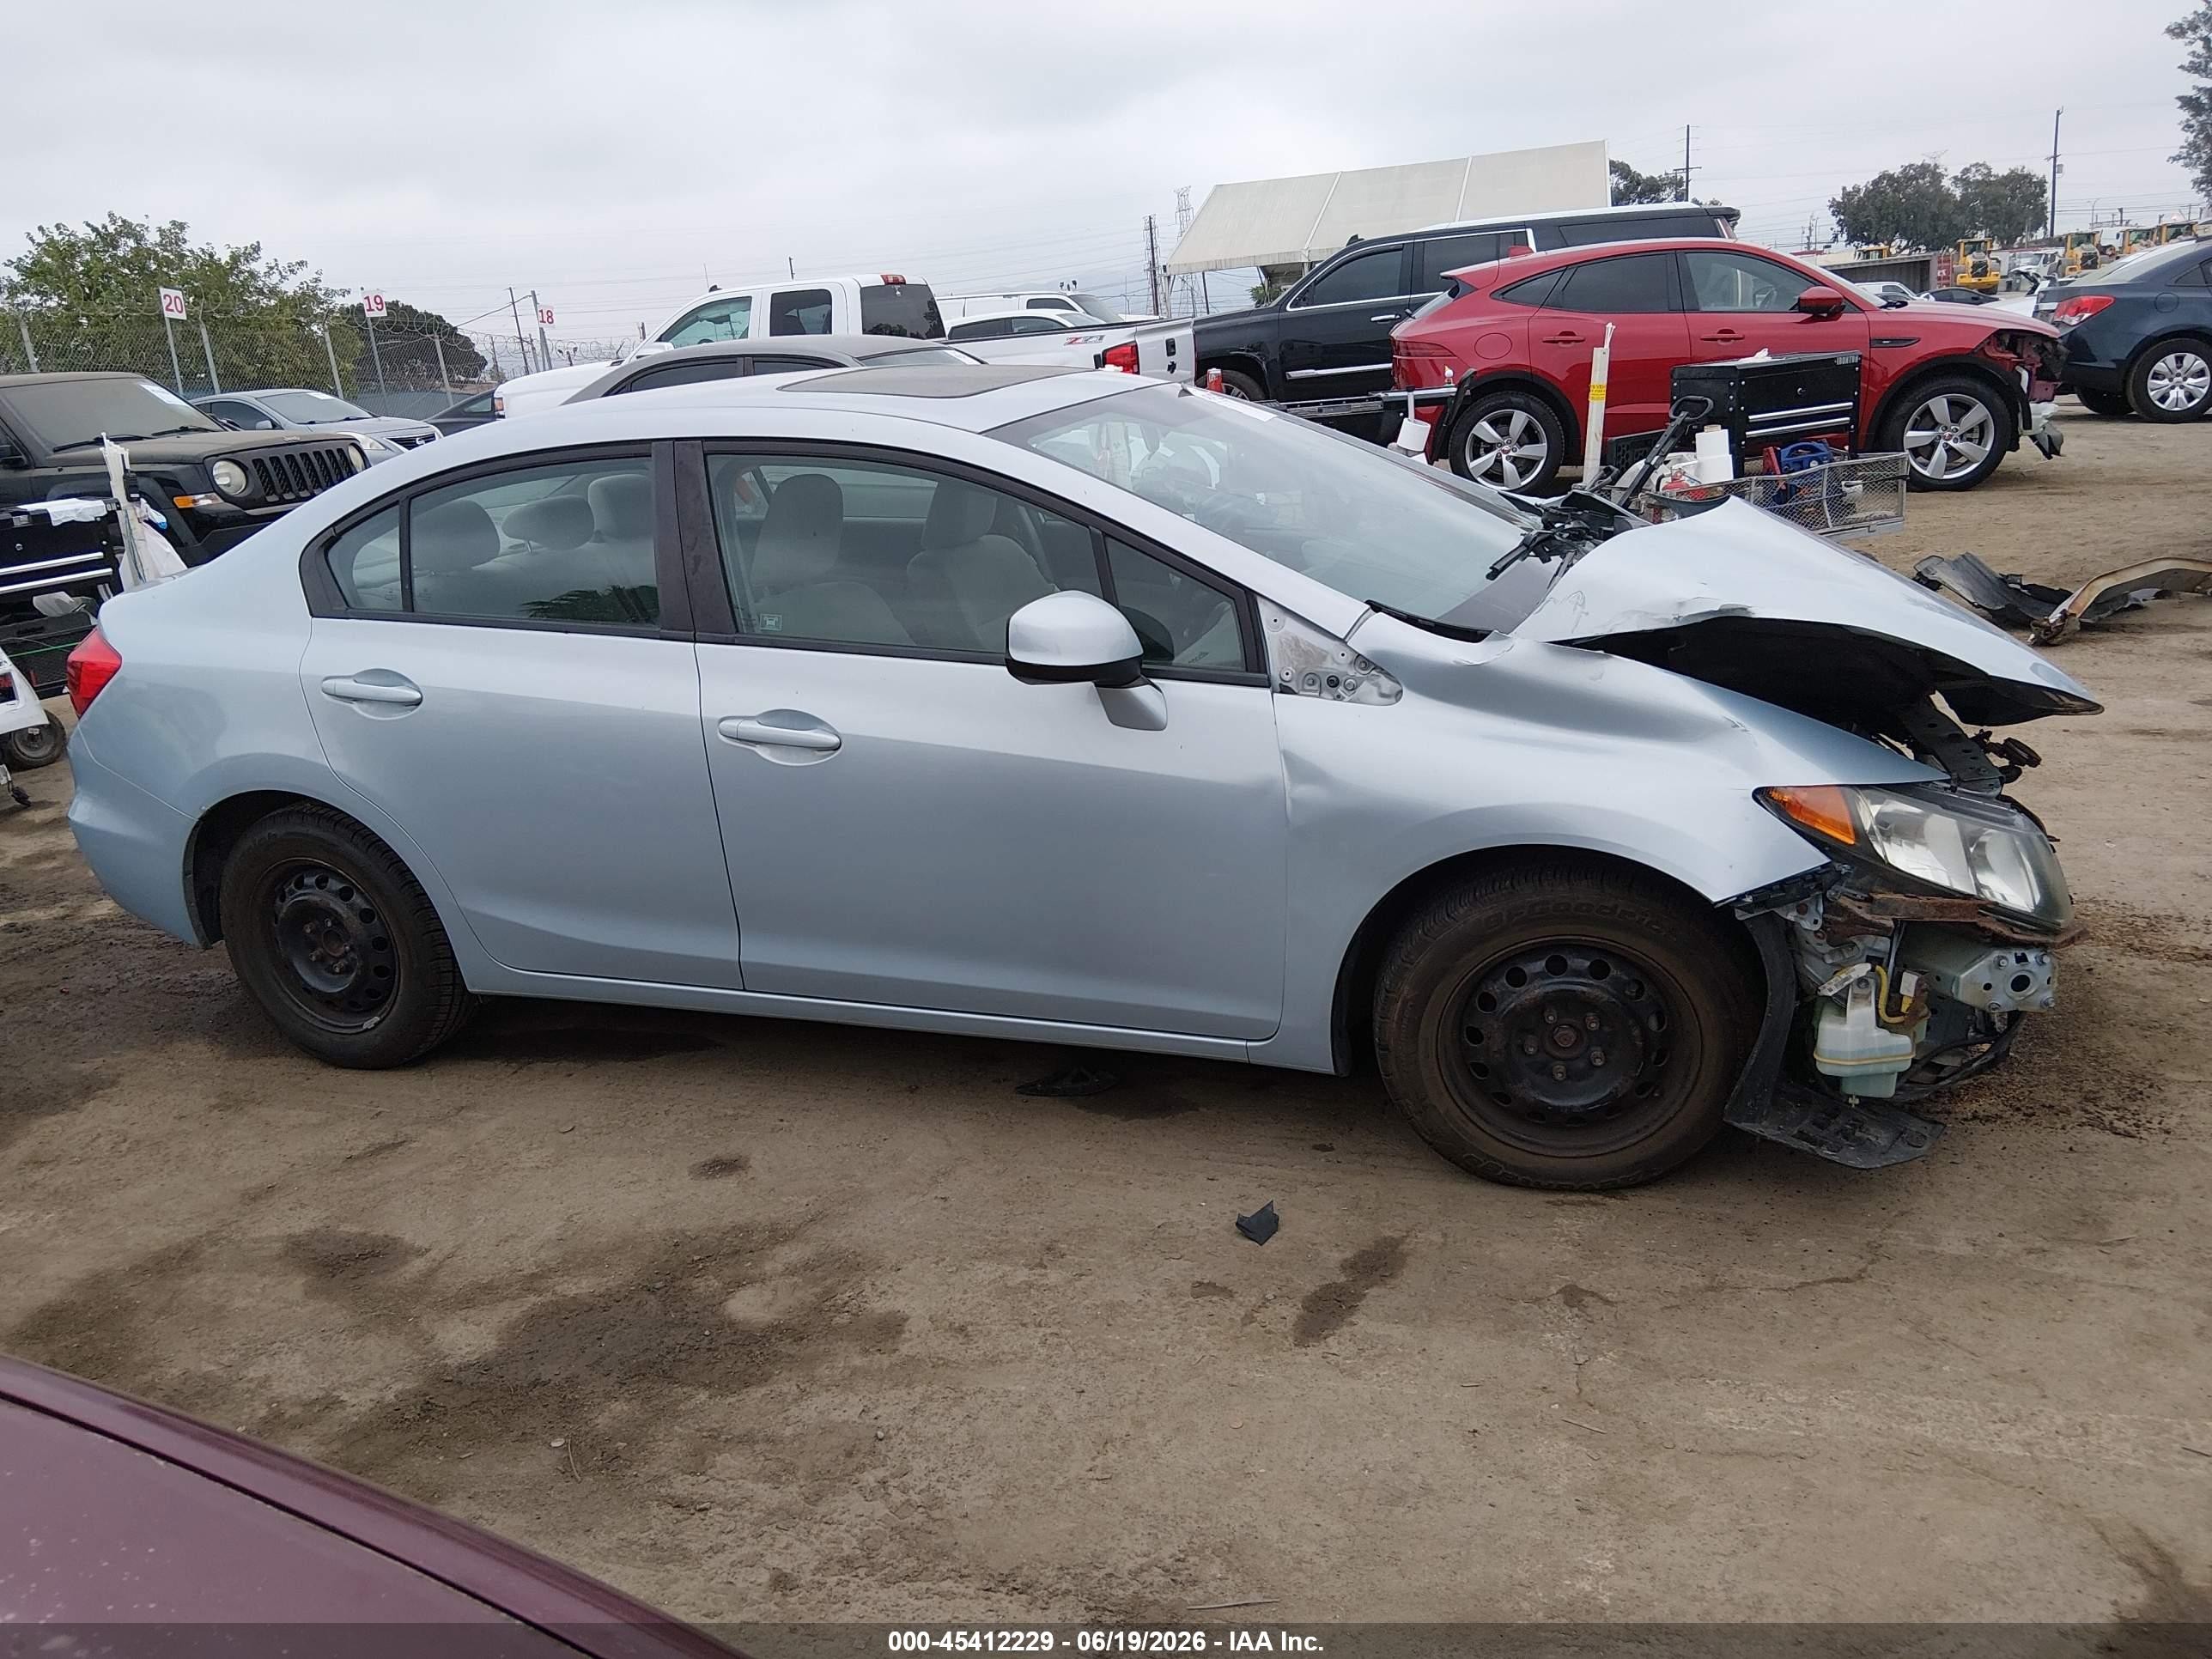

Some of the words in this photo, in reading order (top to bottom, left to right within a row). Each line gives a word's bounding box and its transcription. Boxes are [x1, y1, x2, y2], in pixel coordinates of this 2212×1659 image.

[163, 294, 183, 313] 20
[364, 295, 384, 312] 19
[538, 309, 554, 324] 18
